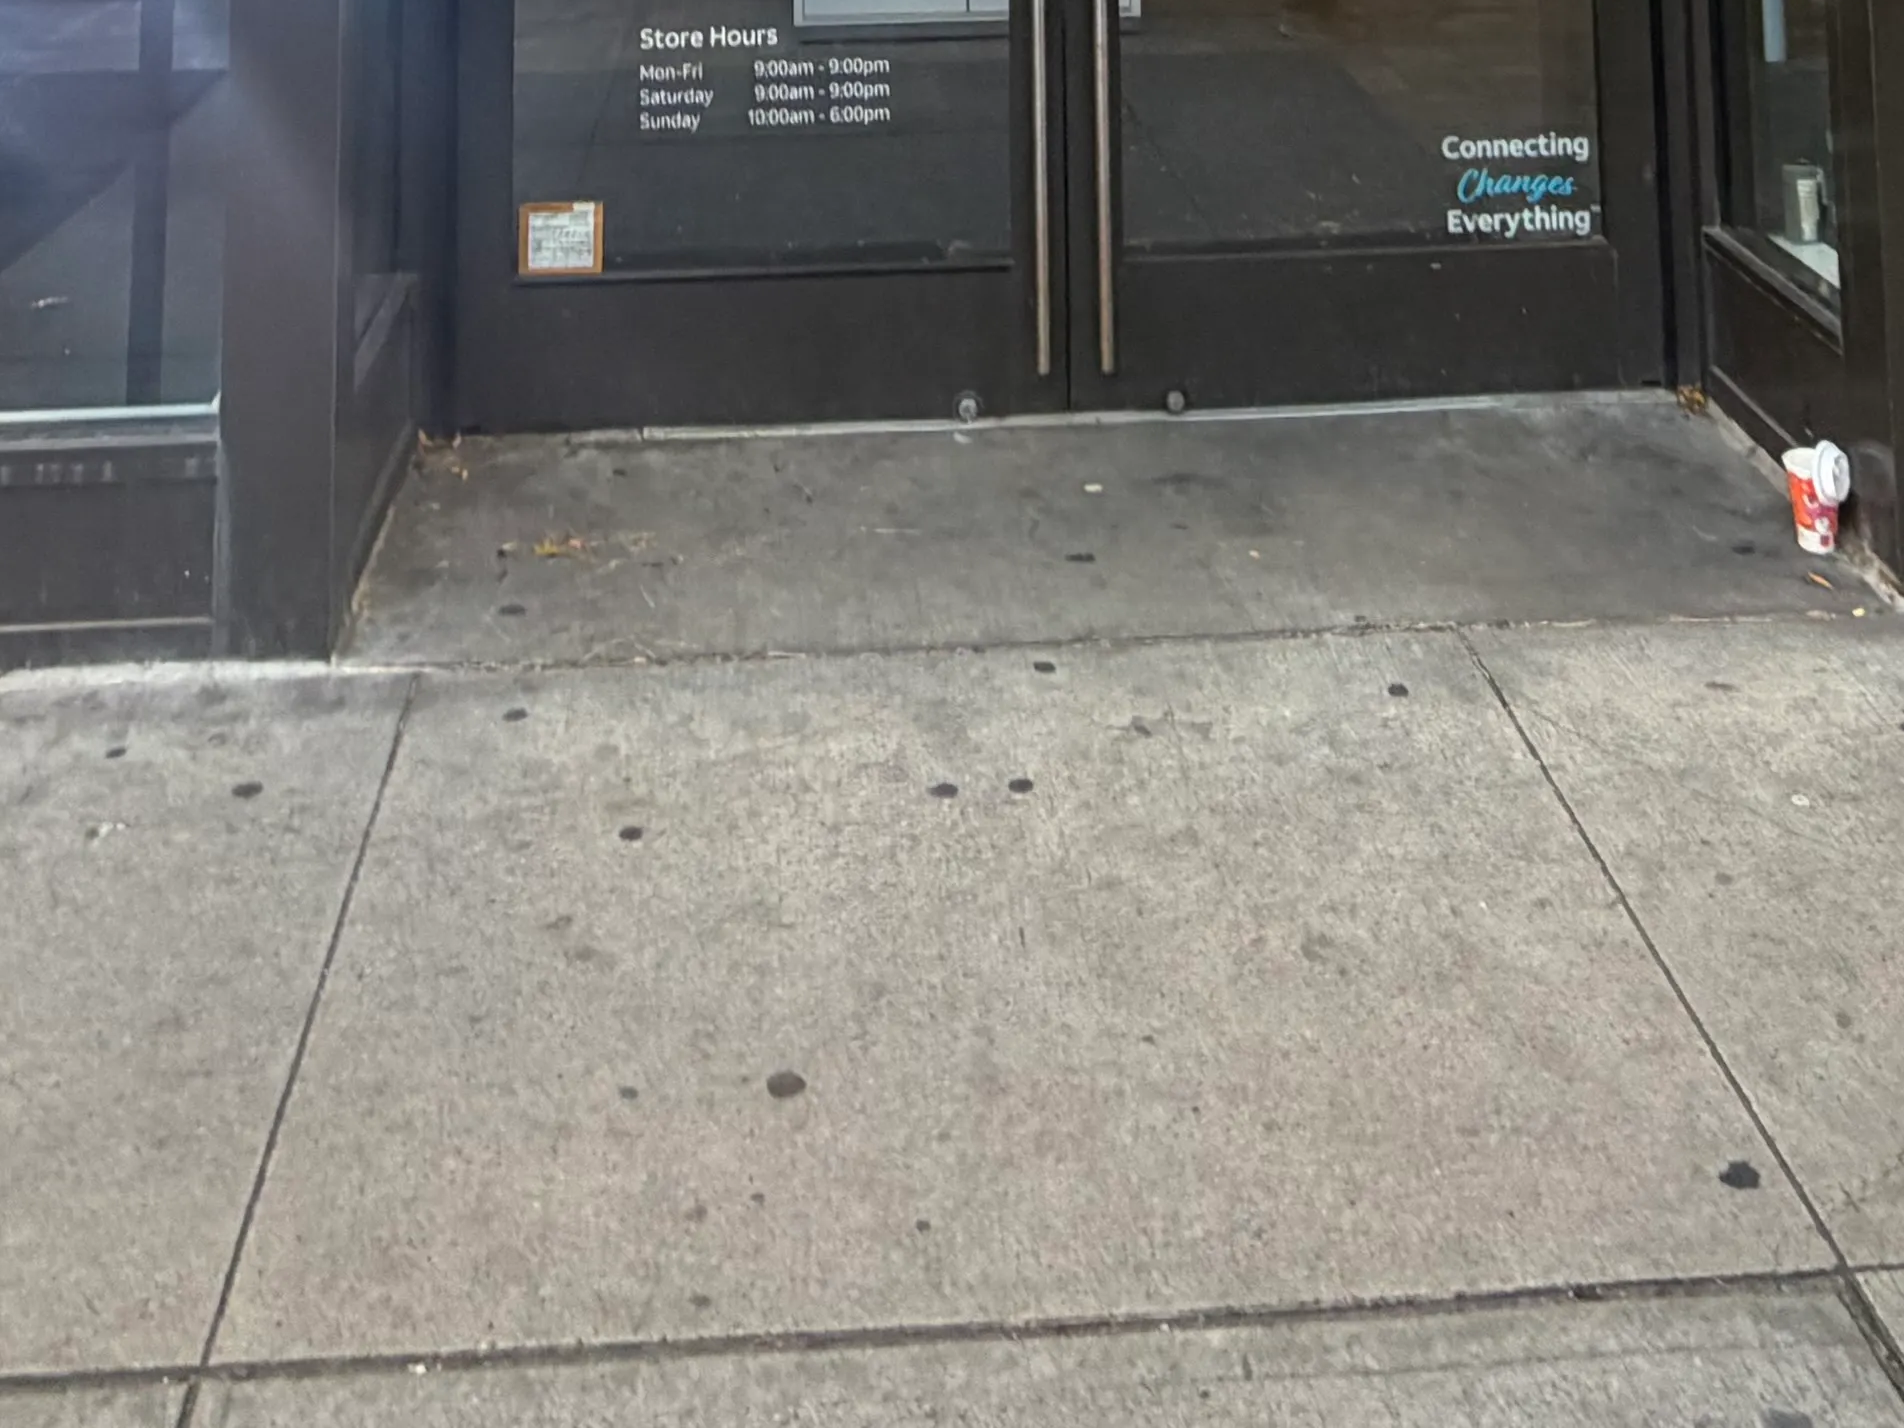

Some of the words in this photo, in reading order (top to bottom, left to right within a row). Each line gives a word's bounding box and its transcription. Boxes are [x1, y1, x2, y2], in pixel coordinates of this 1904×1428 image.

[640, 28, 703, 50] Store
[710, 25, 778, 48] Hours
[639, 61, 703, 82] Mon-Fri
[753, 59, 814, 79] 9:00am
[828, 57, 890, 77] 9:00pm
[639, 87, 714, 108] Saturday
[754, 83, 815, 102] 9:00am
[828, 81, 891, 101] 9:00pm
[639, 111, 701, 133] Sunday
[747, 107, 815, 127] 10:00am
[829, 105, 891, 126] 6:00pm
[1441, 132, 1590, 162] Connecting
[1457, 167, 1577, 204] Changes
